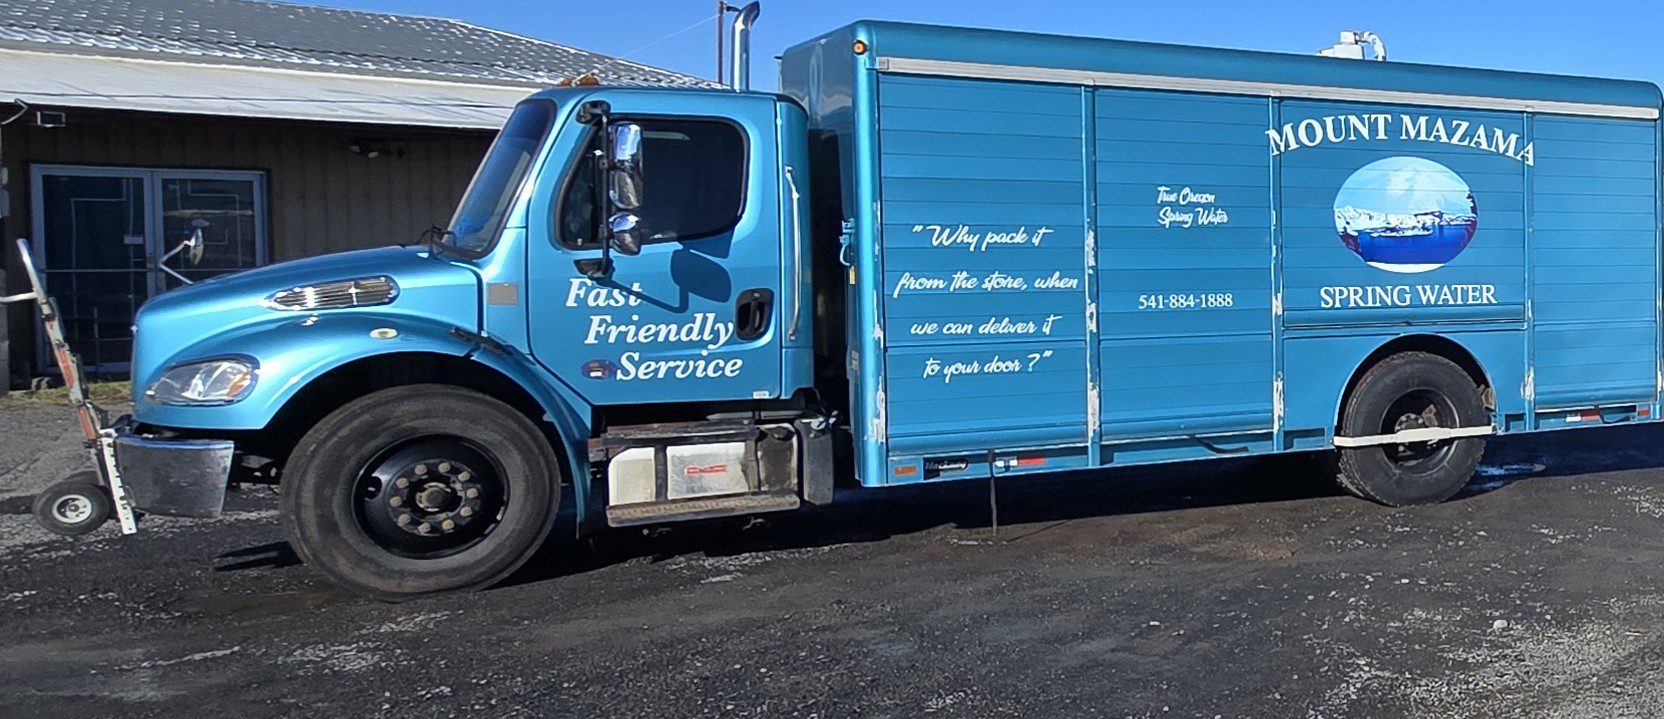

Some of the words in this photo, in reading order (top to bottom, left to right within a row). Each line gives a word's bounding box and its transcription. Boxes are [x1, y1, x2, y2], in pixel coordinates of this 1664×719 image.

[1264, 113, 1392, 156] MOUNT
[1399, 114, 1535, 167] MAZAMA
[1157, 186, 1178, 204] True
[1157, 206, 1194, 229] Spring
[1195, 207, 1229, 226] Water
[980, 226, 1028, 252] pack
[1031, 226, 1055, 247] it
[565, 276, 644, 308] Fast
[892, 271, 948, 299] from
[949, 271, 979, 292] the
[981, 270, 1028, 292] store,
[1033, 271, 1079, 289] when
[1319, 285, 1412, 308] SPRING
[1415, 284, 1498, 305] WATER
[1138, 292, 1234, 310] 541-884-1888
[583, 312, 735, 350] Friendly
[910, 321, 940, 335] we
[942, 321, 973, 335] can
[978, 316, 1037, 335] deliver
[1041, 313, 1064, 336] it
[615, 350, 744, 381] Service
[922, 356, 941, 379] to
[942, 360, 981, 384] your
[983, 355, 1023, 374] door
